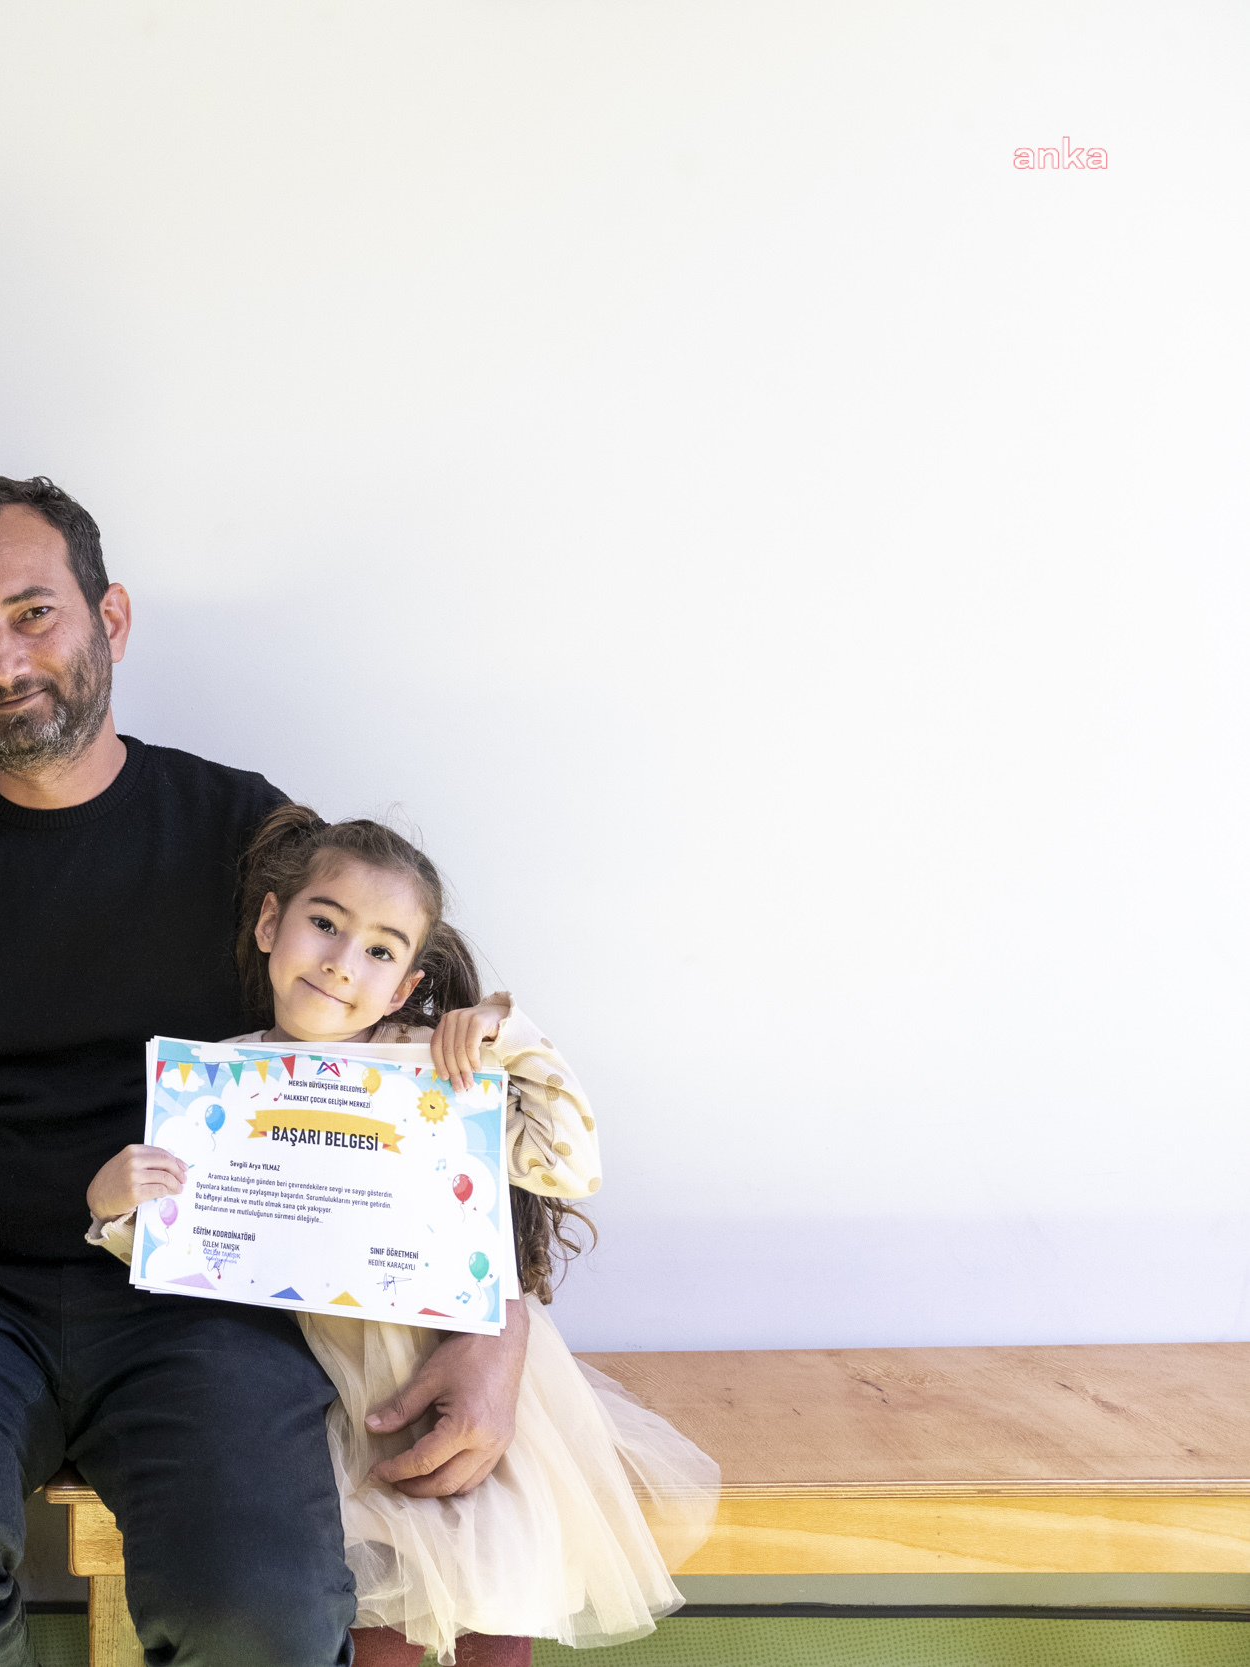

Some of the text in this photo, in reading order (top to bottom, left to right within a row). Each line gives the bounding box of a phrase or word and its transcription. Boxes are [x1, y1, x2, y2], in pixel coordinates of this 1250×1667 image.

[308, 1081, 339, 1091] BÜYÜKŞEHİR
[340, 1084, 367, 1093] BELEDİYESİ
[284, 1094, 371, 1108] HALKKENT ÇOCUK GELİŞİM MERKEZİ
[272, 1126, 378, 1151] BAŞARI BELGESİ
[230, 1160, 247, 1169] Sevgili
[231, 1175, 255, 1184] katıldığın
[289, 1182, 328, 1191] çevrendekilere
[329, 1186, 343, 1194] sevgi
[196, 1182, 219, 1190] Oyunlara
[249, 1189, 279, 1198] paylaşmayı
[306, 1194, 350, 1204] Sorumluluklarını
[204, 1193, 222, 1202] belgeyi
[195, 1203, 228, 1212] Başarılarının
[237, 1209, 273, 1218] mutluluğunun
[274, 1212, 295, 1220] sürmesi
[193, 1226, 255, 1241] EĞİTİM KOORDİNATÖRÜ
[202, 1240, 240, 1251] ÖZLEM TANIŞIK
[370, 1247, 419, 1259] SINIF ÖĞRETMENİ
[387, 1261, 415, 1271] KARAÇAYLI
